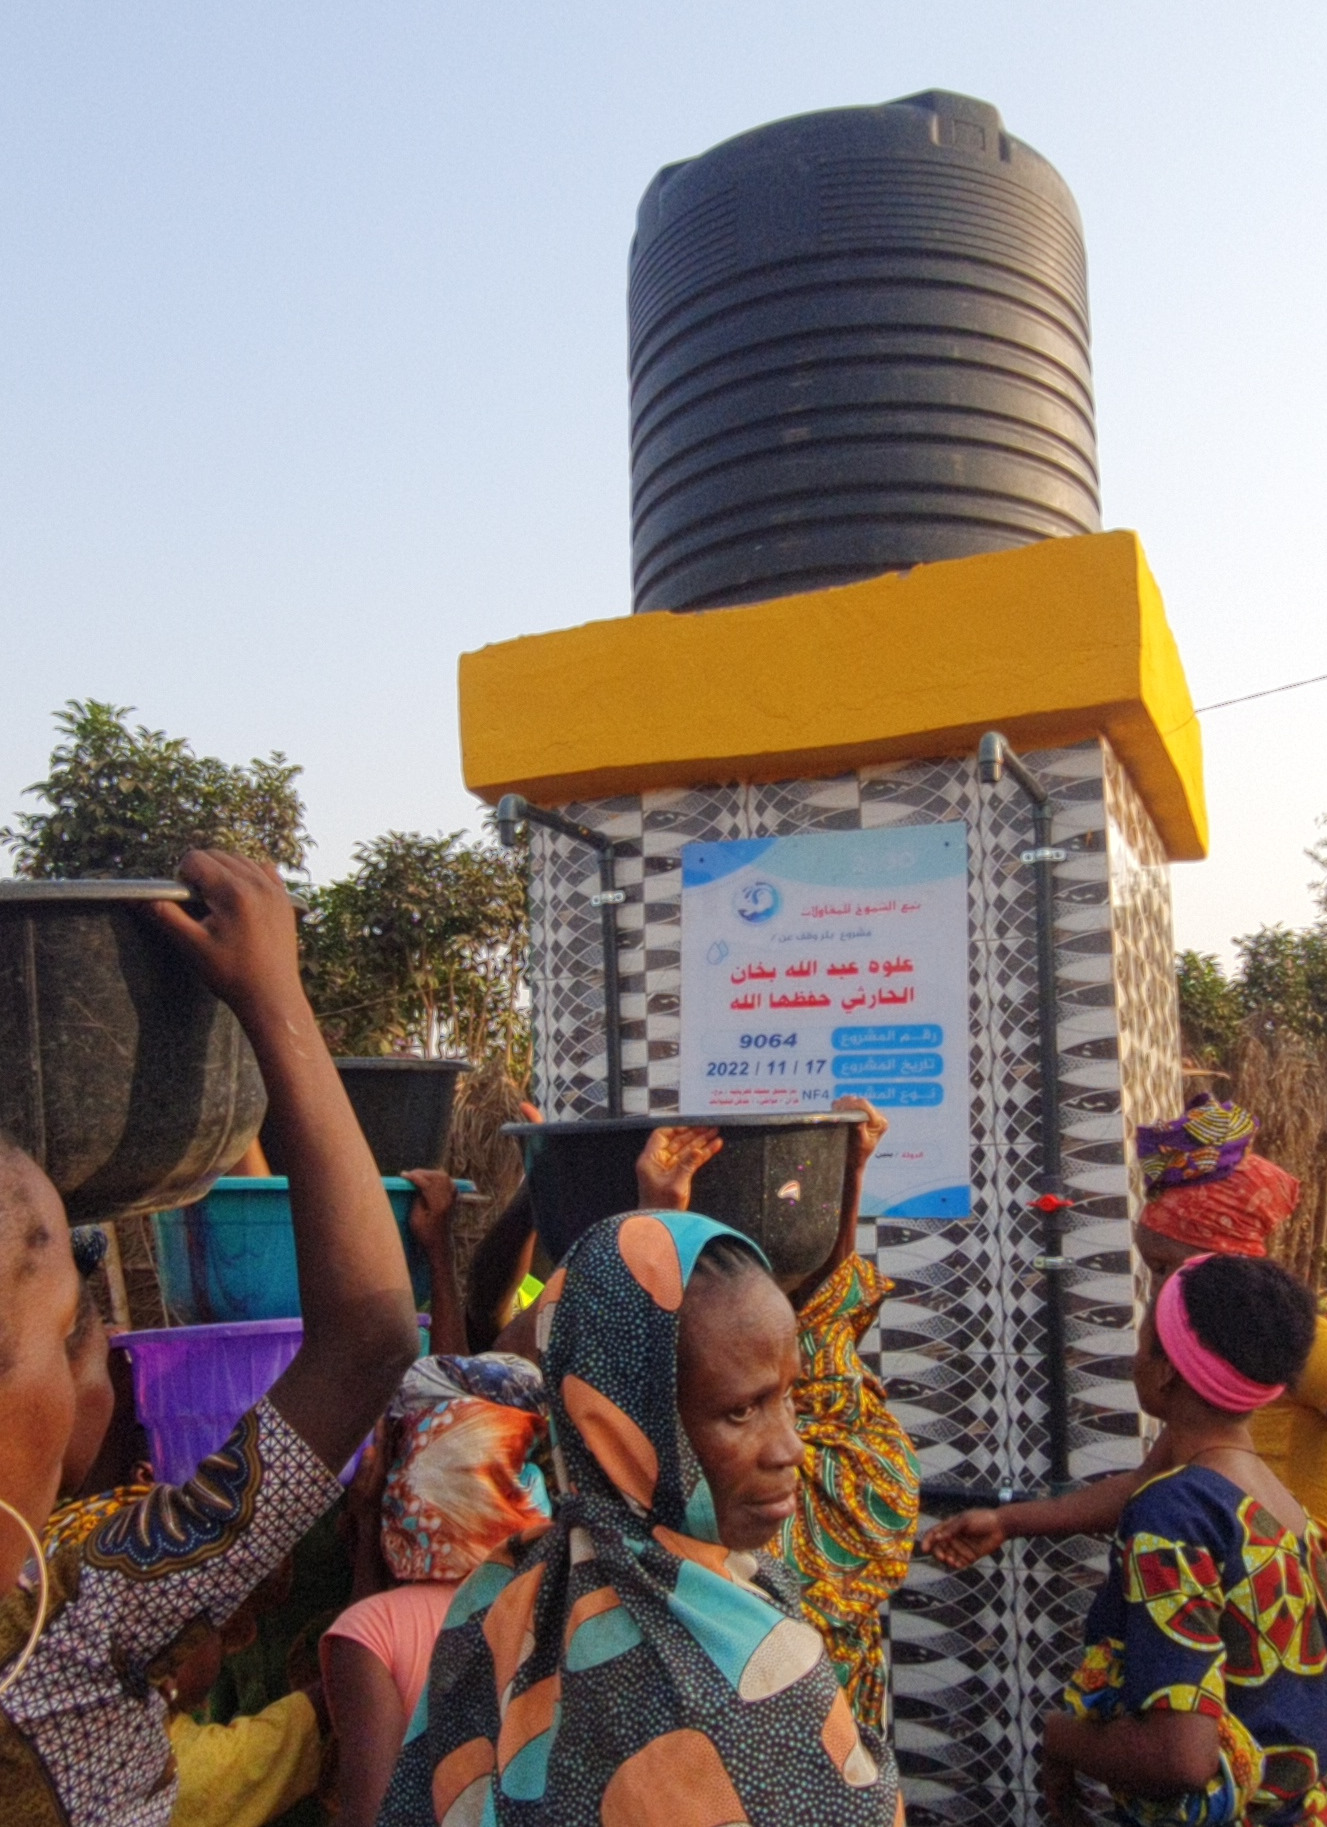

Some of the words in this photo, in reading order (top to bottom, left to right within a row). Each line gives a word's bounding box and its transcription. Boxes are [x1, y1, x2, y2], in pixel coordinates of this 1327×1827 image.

[785, 960, 817, 978] الله
[826, 961, 859, 980] عبد
[730, 993, 761, 1010] الله
[769, 990, 831, 1009] حفظها
[841, 987, 914, 1013] الحارثي
[740, 1033, 797, 1049] 9064
[840, 1028, 896, 1047] المشروع
[706, 1061, 749, 1076] 2022
[767, 1060, 786, 1075] 11
[806, 1060, 827, 1074] 17
[840, 1058, 896, 1076] المشروع
[802, 1089, 829, 1100] NF4
